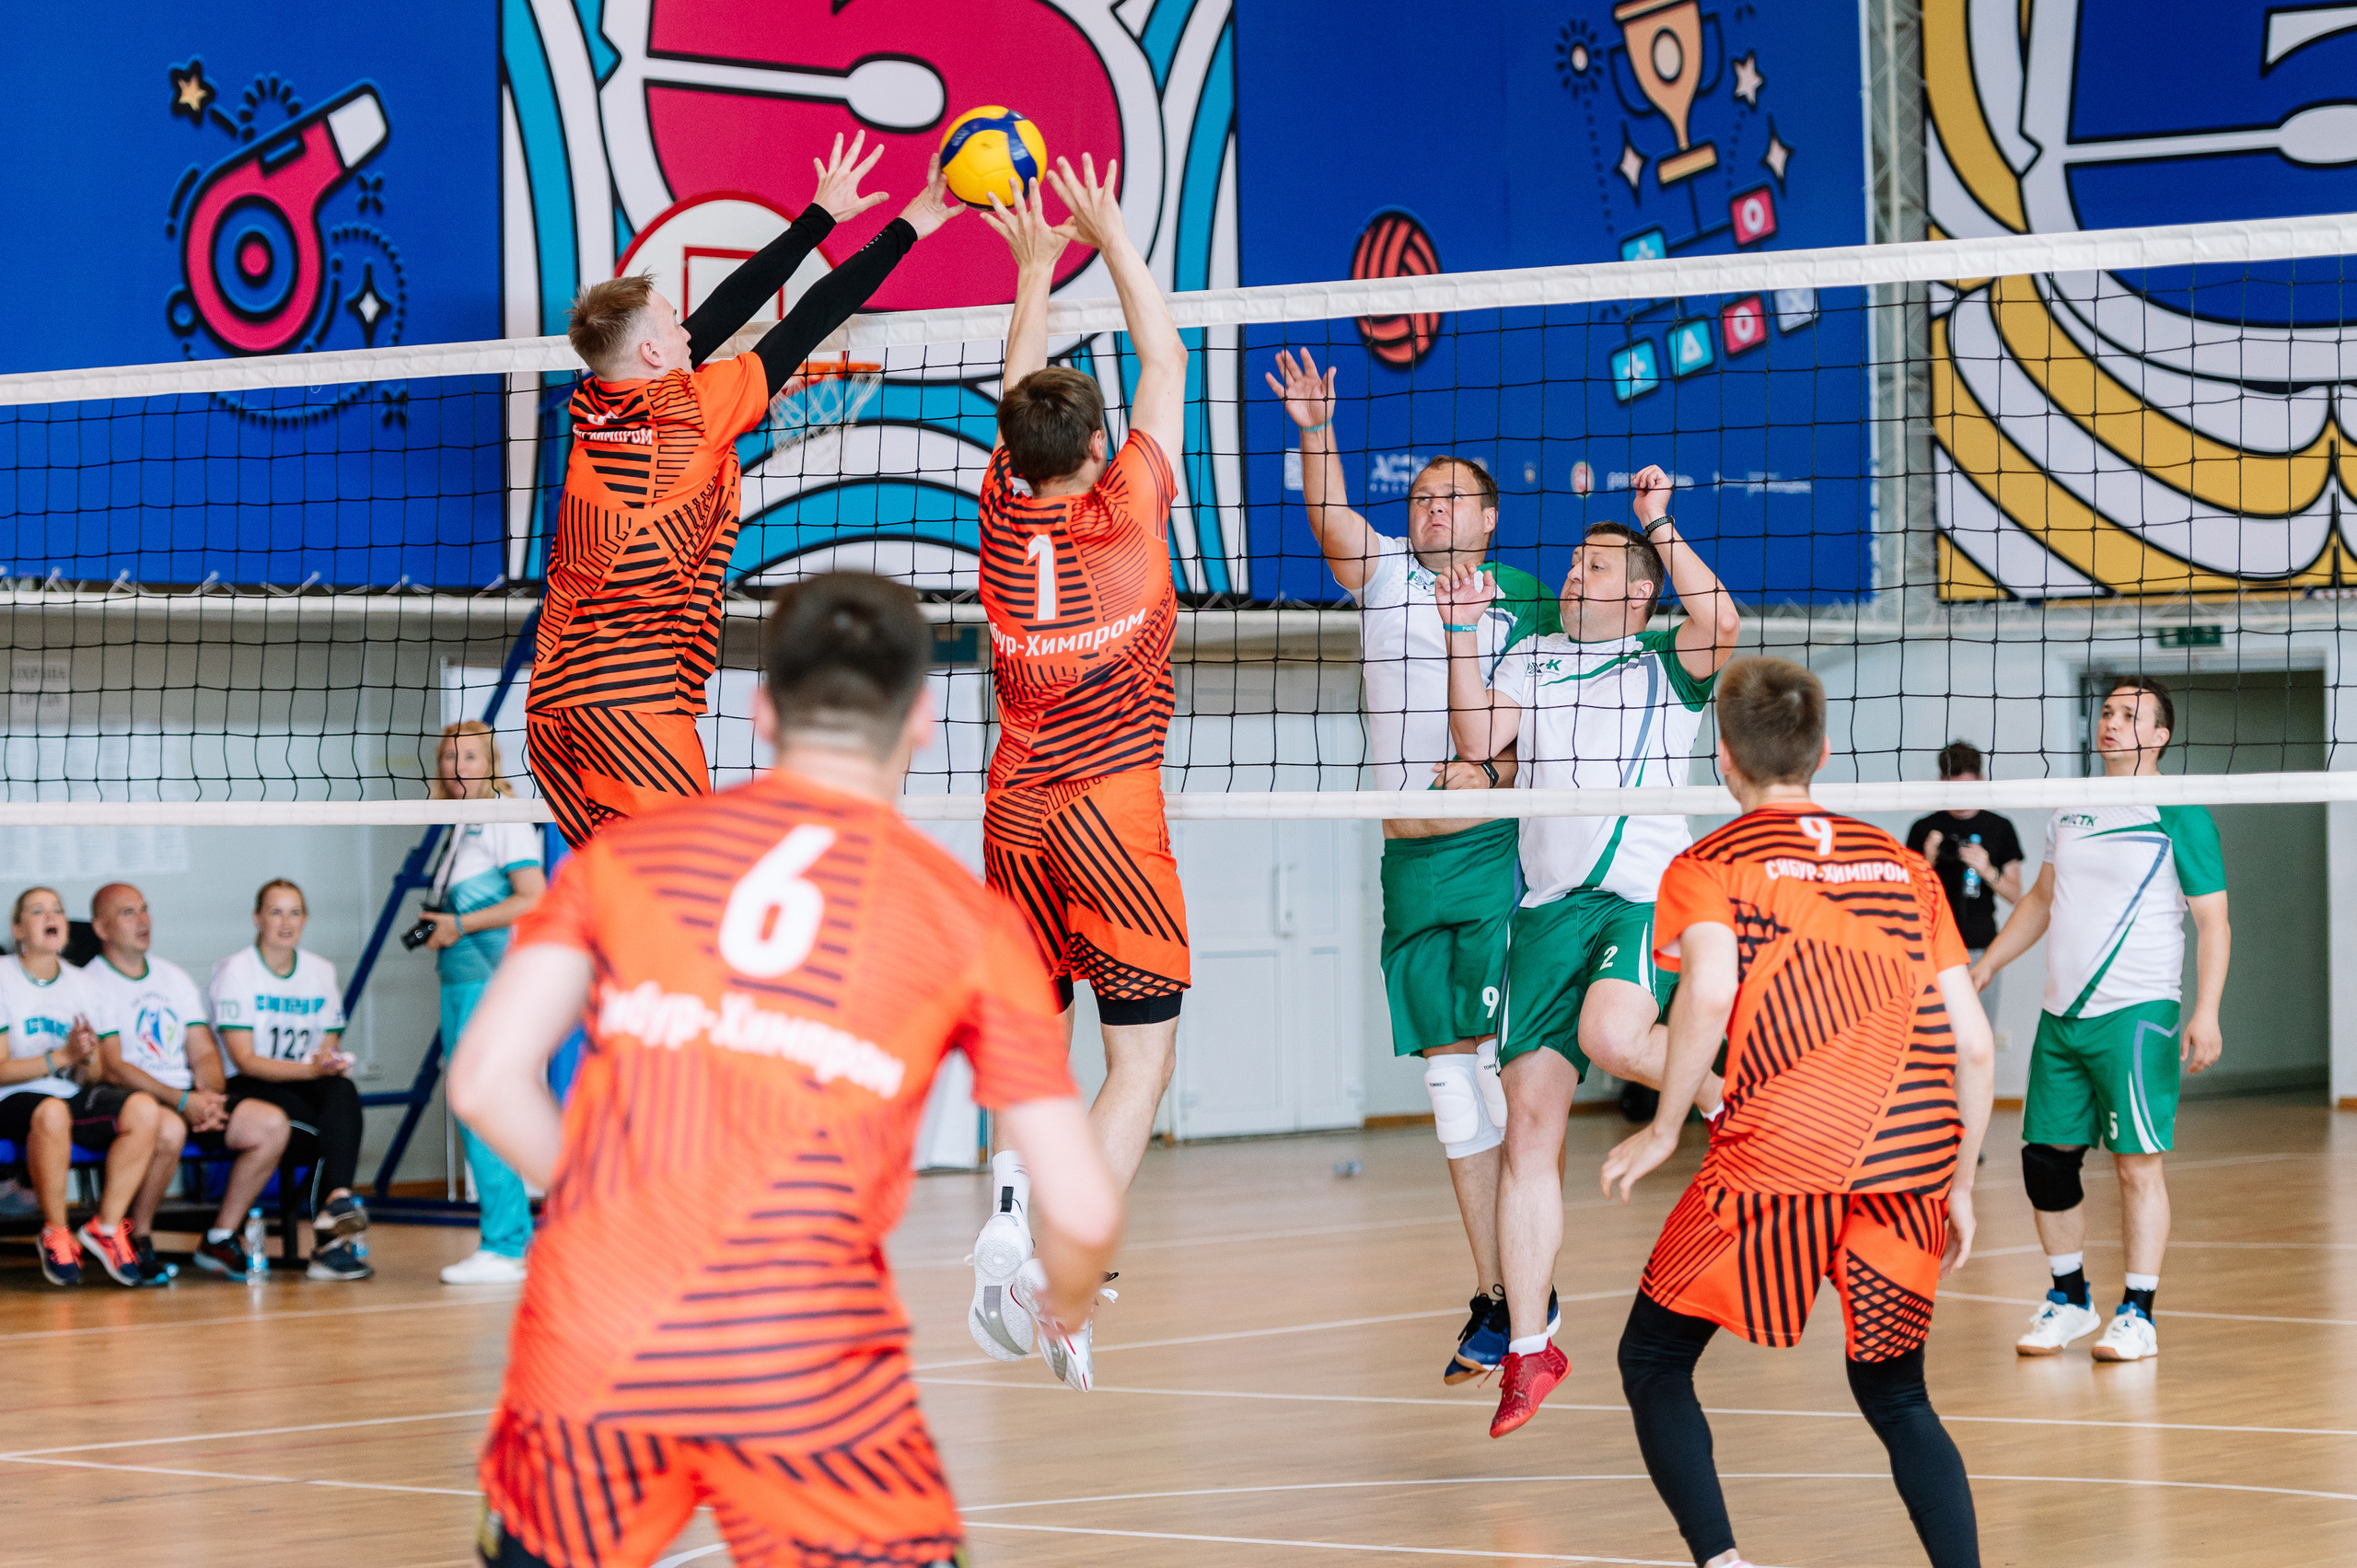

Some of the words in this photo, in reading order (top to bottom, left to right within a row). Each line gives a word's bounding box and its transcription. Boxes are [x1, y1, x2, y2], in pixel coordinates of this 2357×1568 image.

[1028, 534, 1057, 621] 1
[1798, 816, 1833, 856] 9
[1765, 857, 1910, 884] СИБУР-ХИМПРОМ
[718, 823, 837, 978] 6
[1599, 945, 1619, 971] 2
[1481, 985, 1500, 1018] 9
[2109, 1110, 2119, 1141] 5
